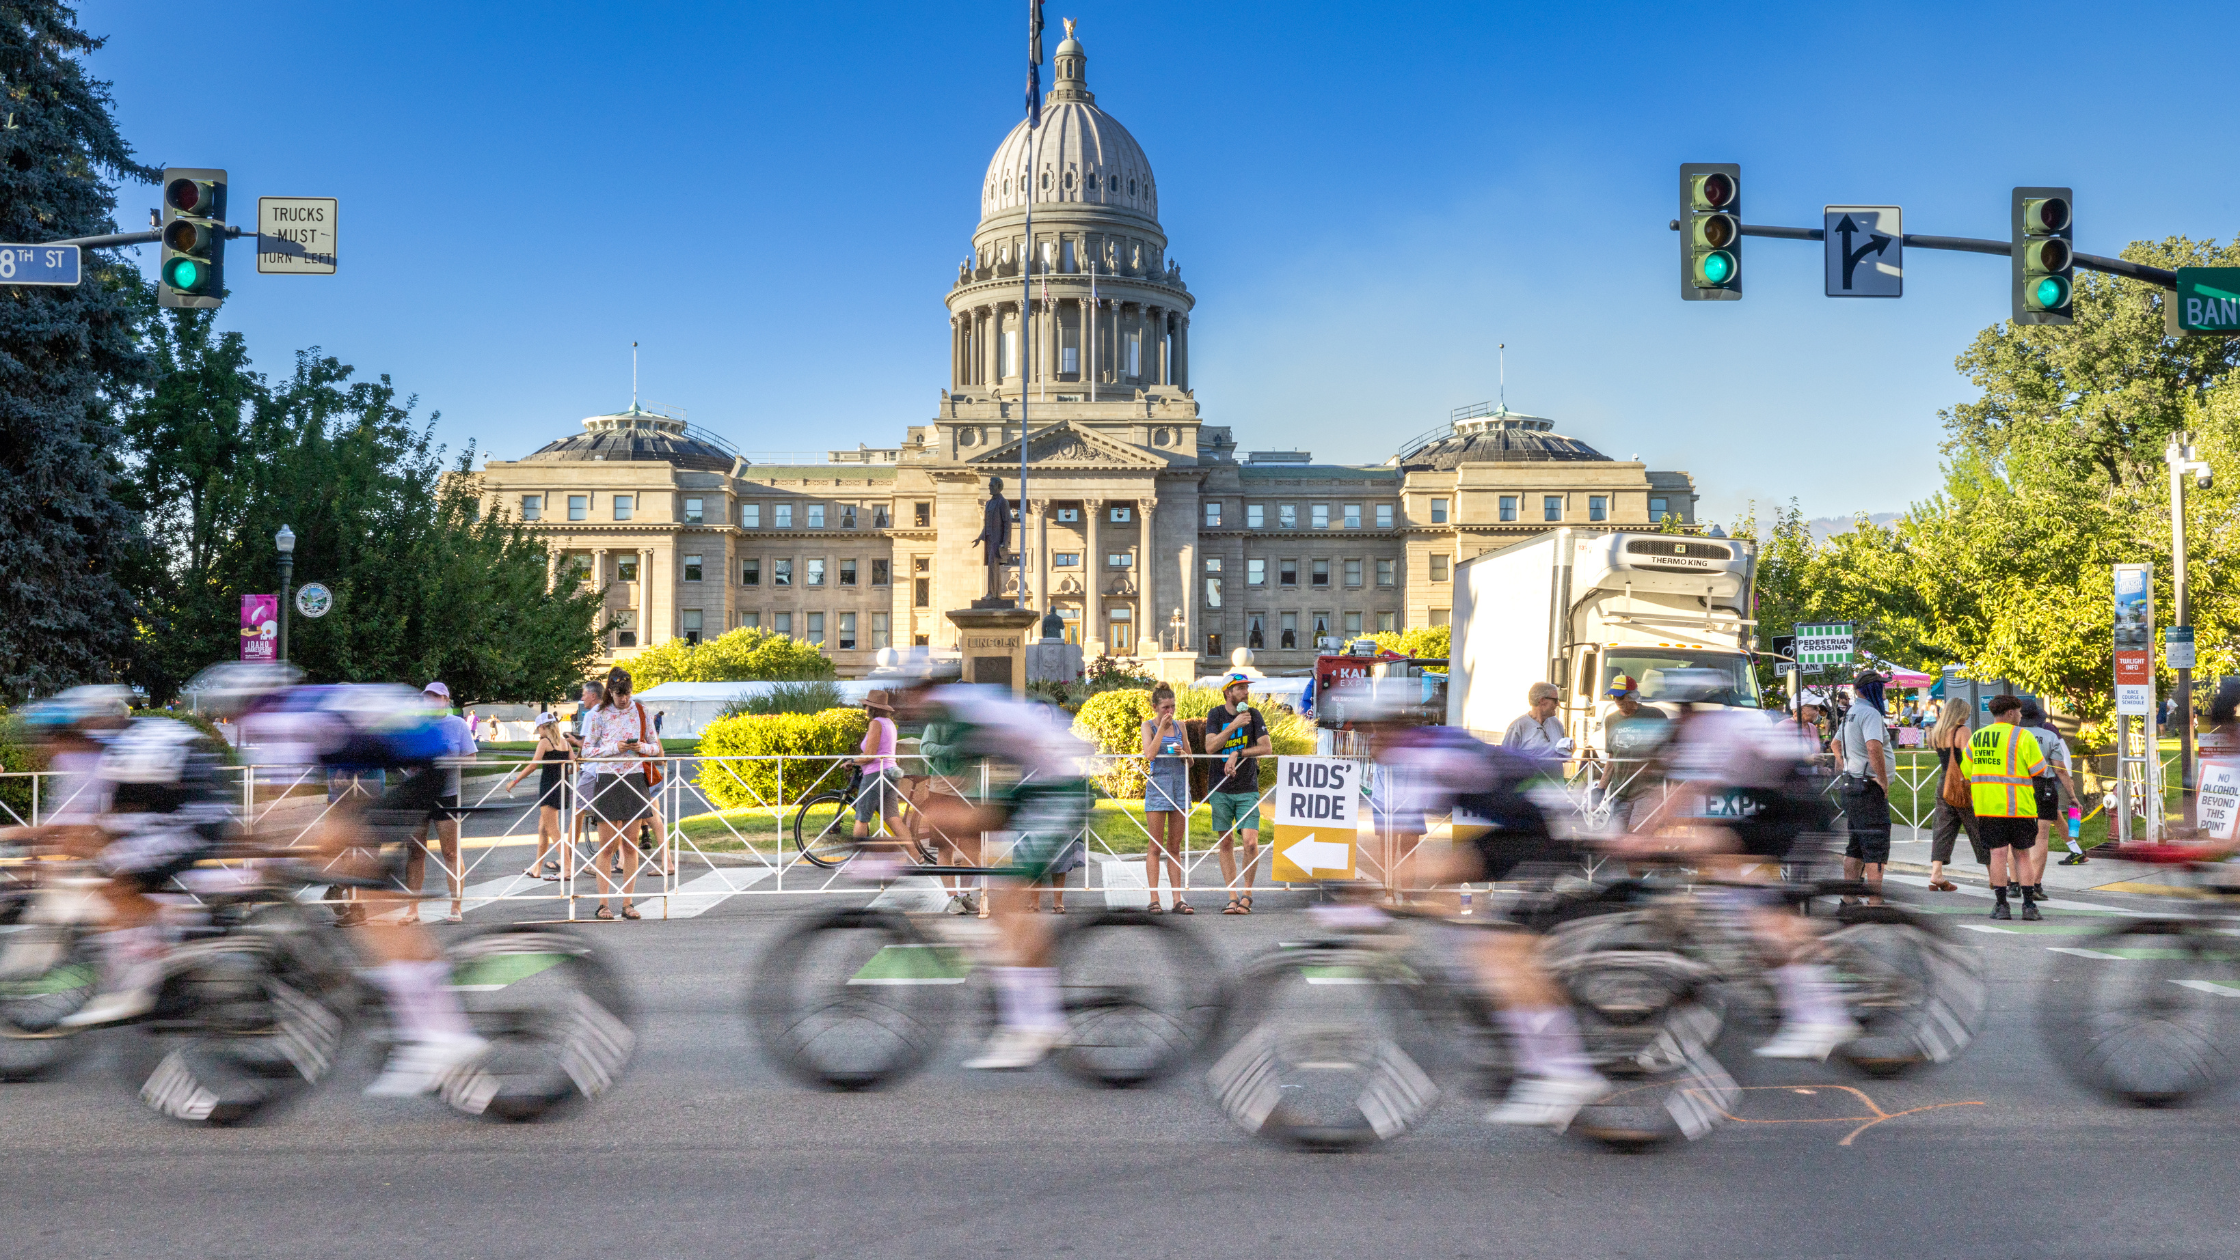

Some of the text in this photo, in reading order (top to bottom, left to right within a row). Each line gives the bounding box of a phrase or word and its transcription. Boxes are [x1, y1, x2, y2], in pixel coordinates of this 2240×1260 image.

[272, 207, 324, 222] TRUCKS
[277, 228, 317, 243] MUST
[0, 249, 65, 279] 8TH ST
[262, 251, 332, 264] TURN LEFT
[2186, 297, 2240, 325] BAN
[1651, 556, 1708, 567] THERMO KING
[247, 640, 269, 648] IDAHO
[967, 637, 1019, 648] LINCOLN
[1798, 638, 1853, 646] PEDESTRIAN
[1800, 663, 1820, 671] LANE
[1973, 731, 2001, 748] MAV
[1973, 757, 2001, 765] ERVICES
[1287, 761, 1352, 790] KIDS'
[2217, 773, 2231, 783] NO
[2202, 783, 2239, 797] ALCOHOL
[1289, 792, 1346, 820] RIDE
[2201, 795, 2236, 809] BEYOND
[2206, 808, 2226, 820] THIS
[2200, 819, 2227, 831] POINT
